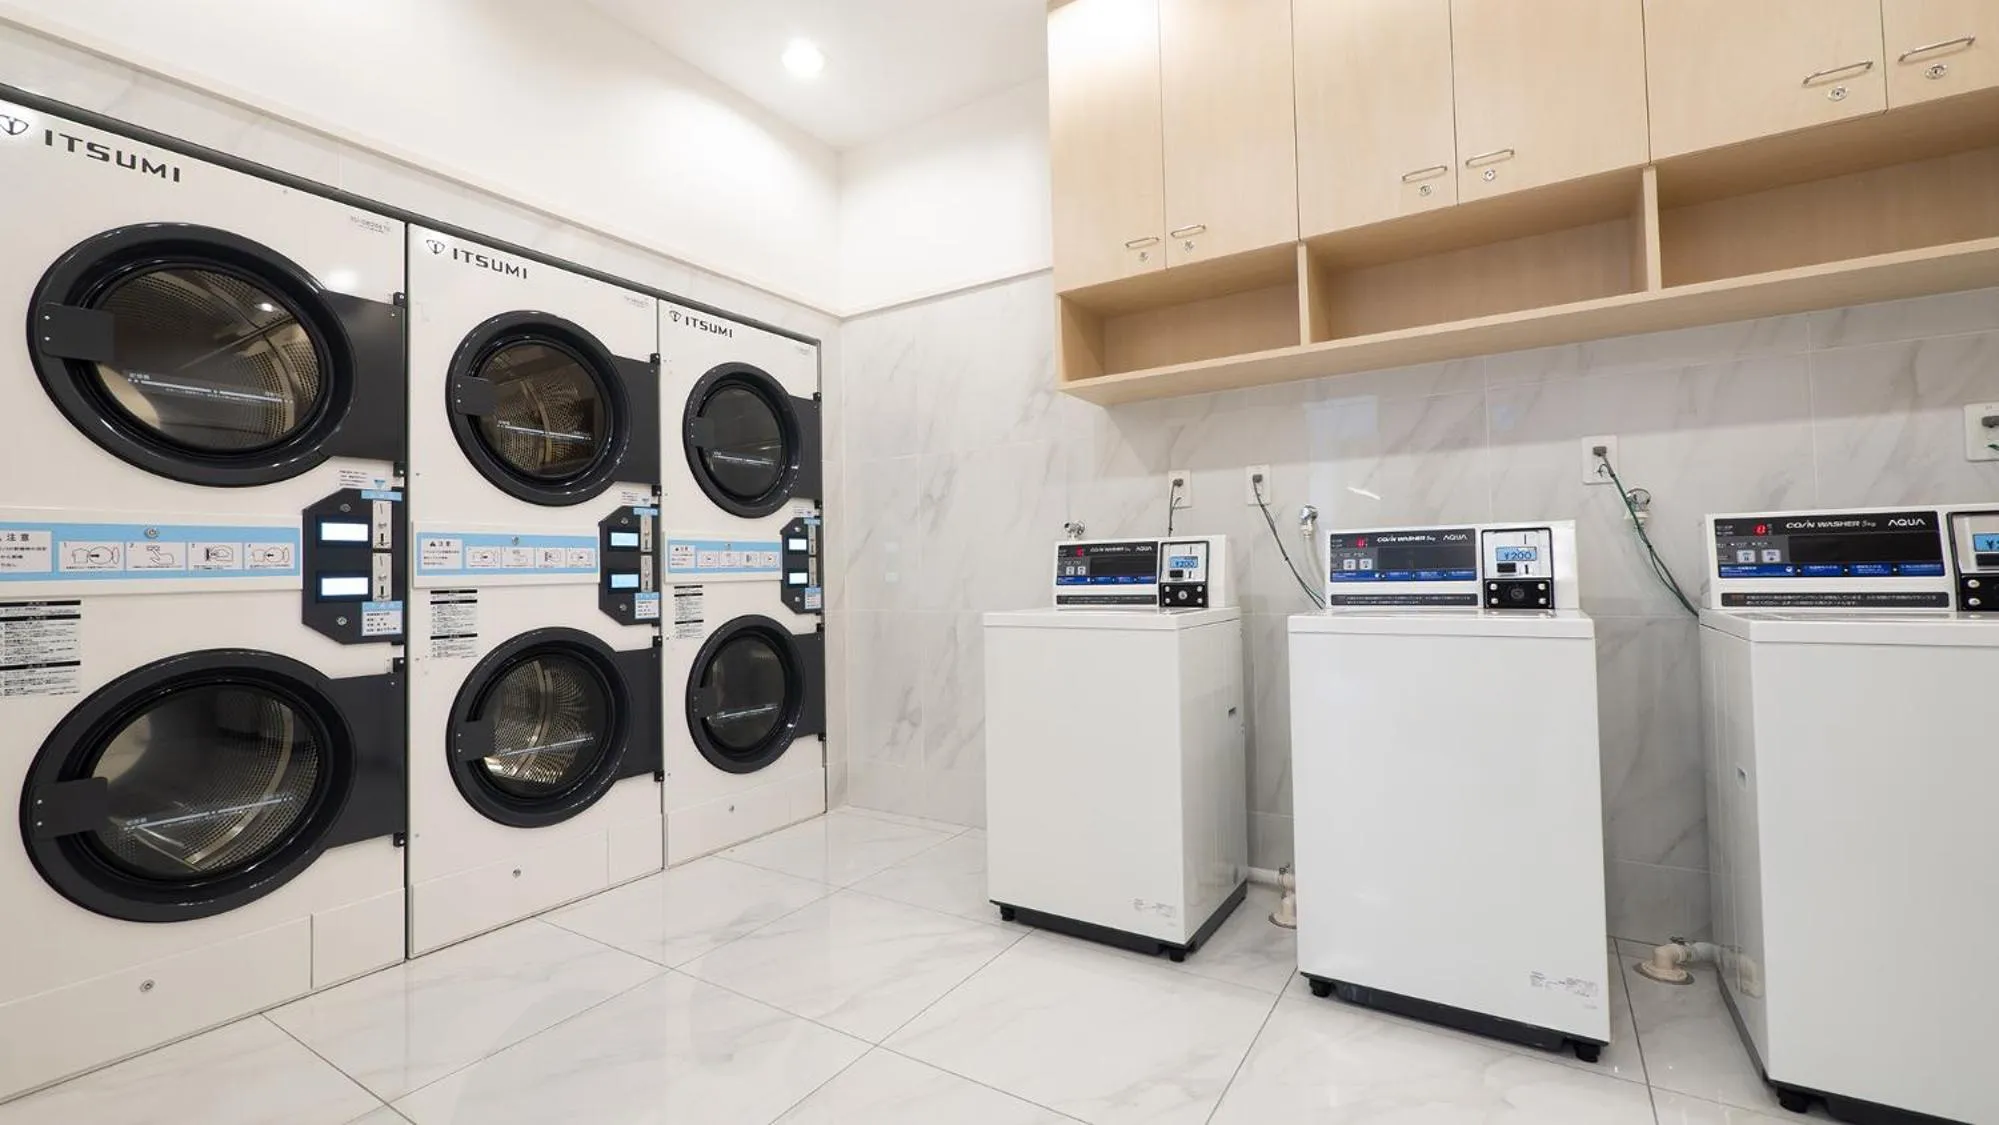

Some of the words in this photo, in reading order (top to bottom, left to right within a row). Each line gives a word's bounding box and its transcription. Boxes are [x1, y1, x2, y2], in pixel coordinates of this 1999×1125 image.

[44, 129, 181, 182] ITSUMI
[452, 247, 528, 280] ITSUMI
[685, 316, 733, 339] ITSUMI
[1816, 520, 1860, 529] WASHER
[1888, 518, 1926, 527] AQUA
[1442, 533, 1468, 542] AQUA
[1503, 550, 1533, 561] ¥200
